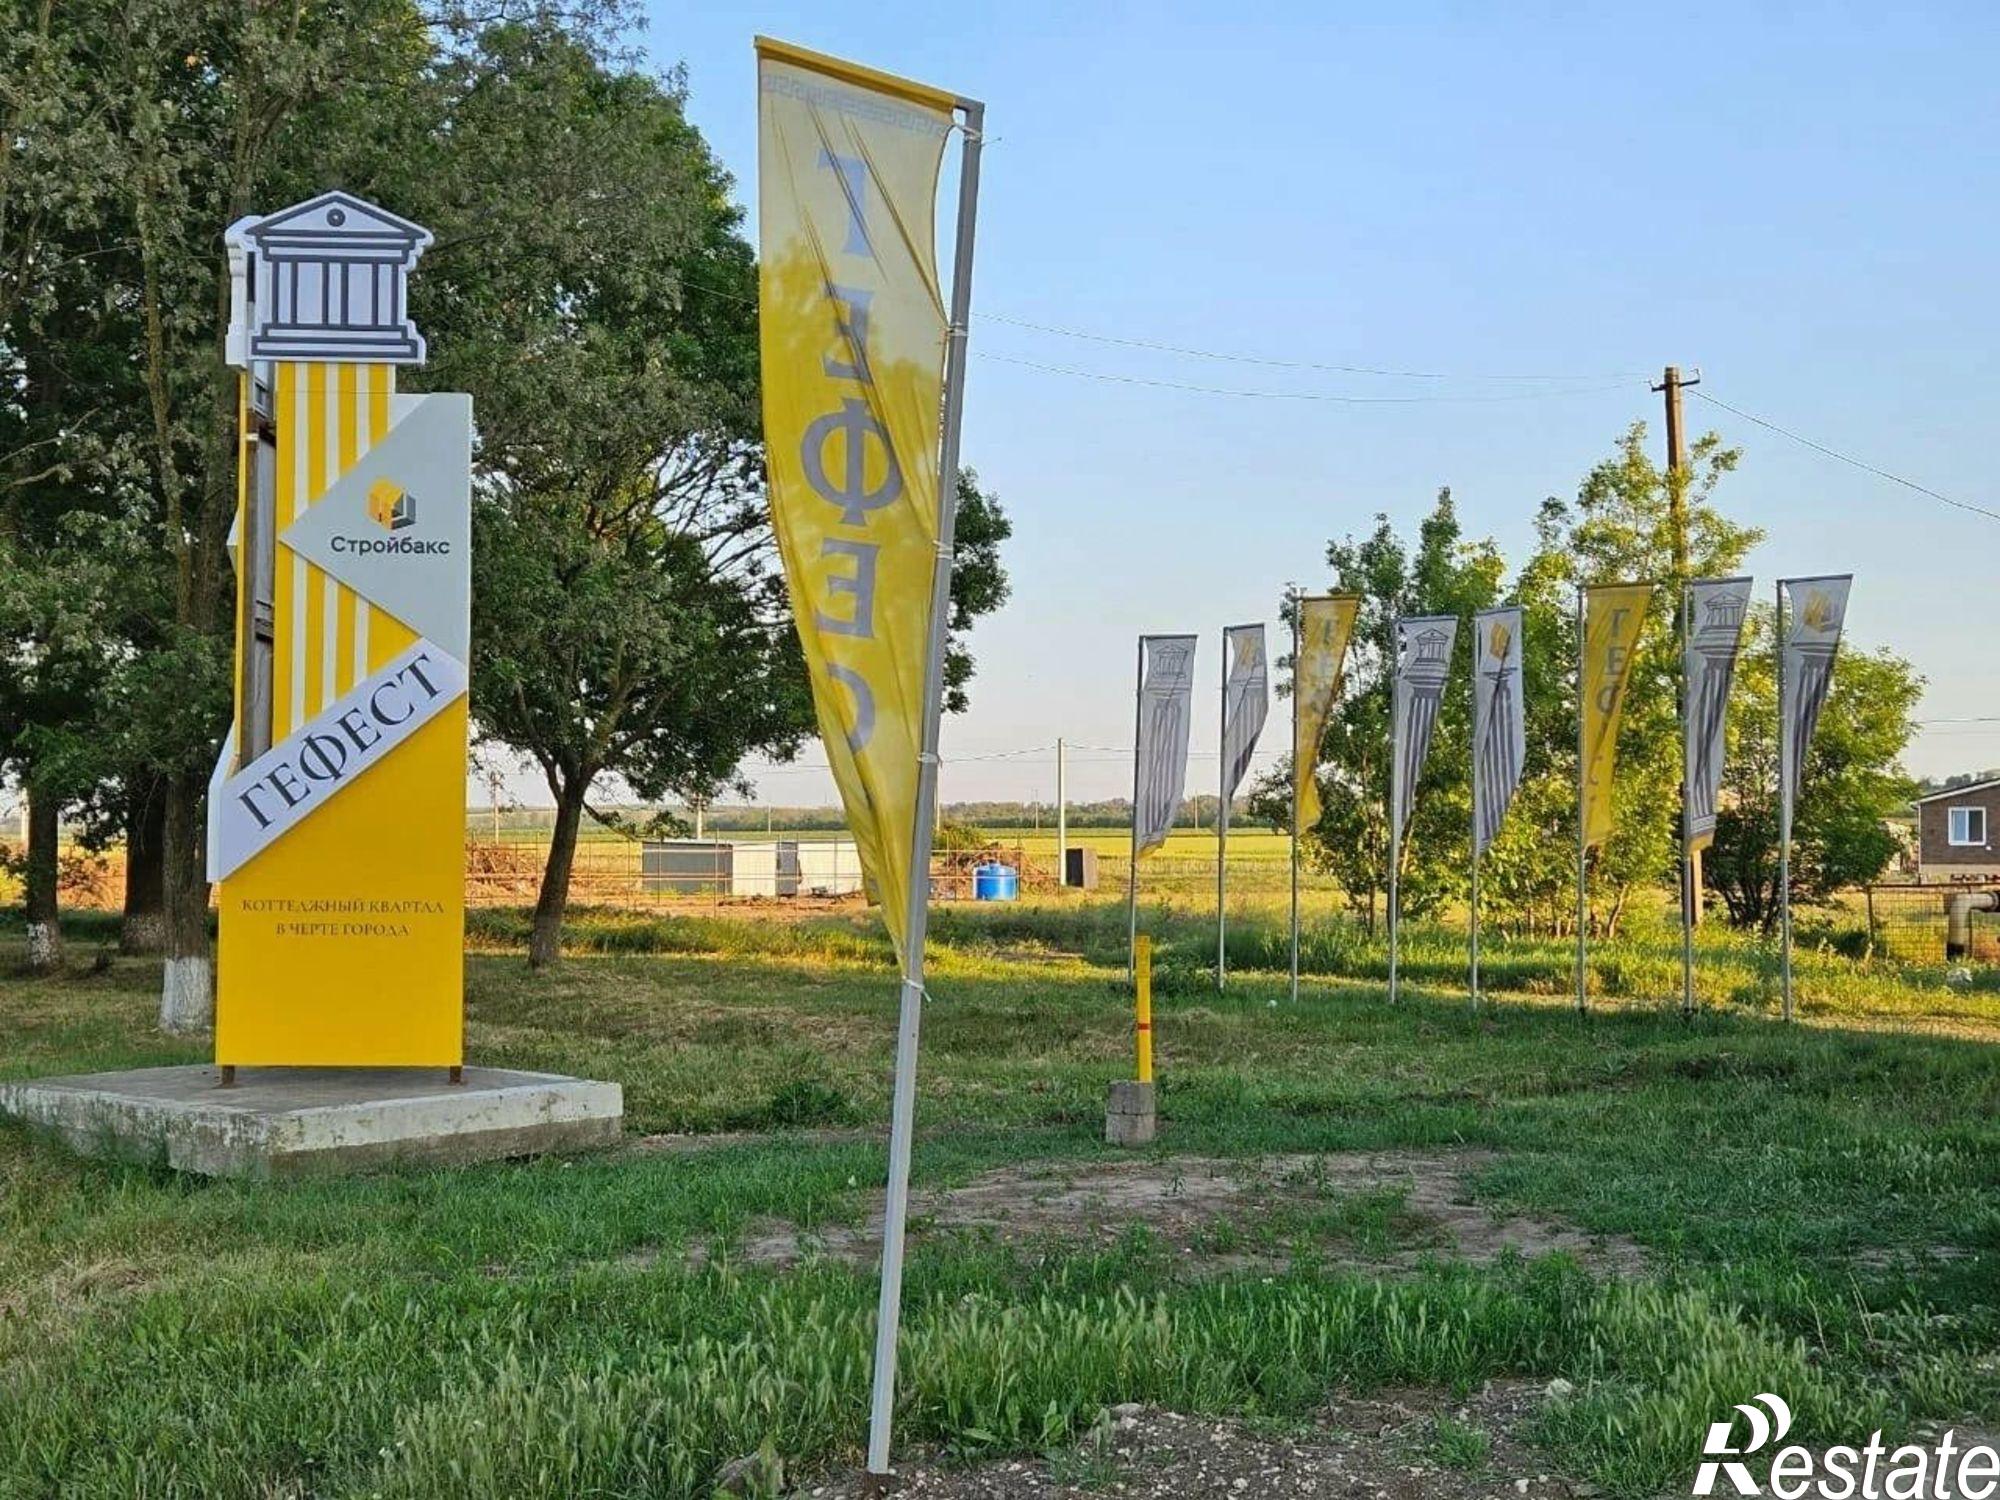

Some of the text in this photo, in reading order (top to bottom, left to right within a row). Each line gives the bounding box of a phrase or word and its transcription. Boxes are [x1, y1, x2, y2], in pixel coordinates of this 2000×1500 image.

[330, 535, 450, 556] Стройбакс
[237, 653, 444, 832] ГЕФЕСТ
[241, 898, 444, 914] КОТТЕДЖНЫЙ КВАРТАЛ
[275, 922, 410, 938] В ЧЕРТЕ ГОРОДА
